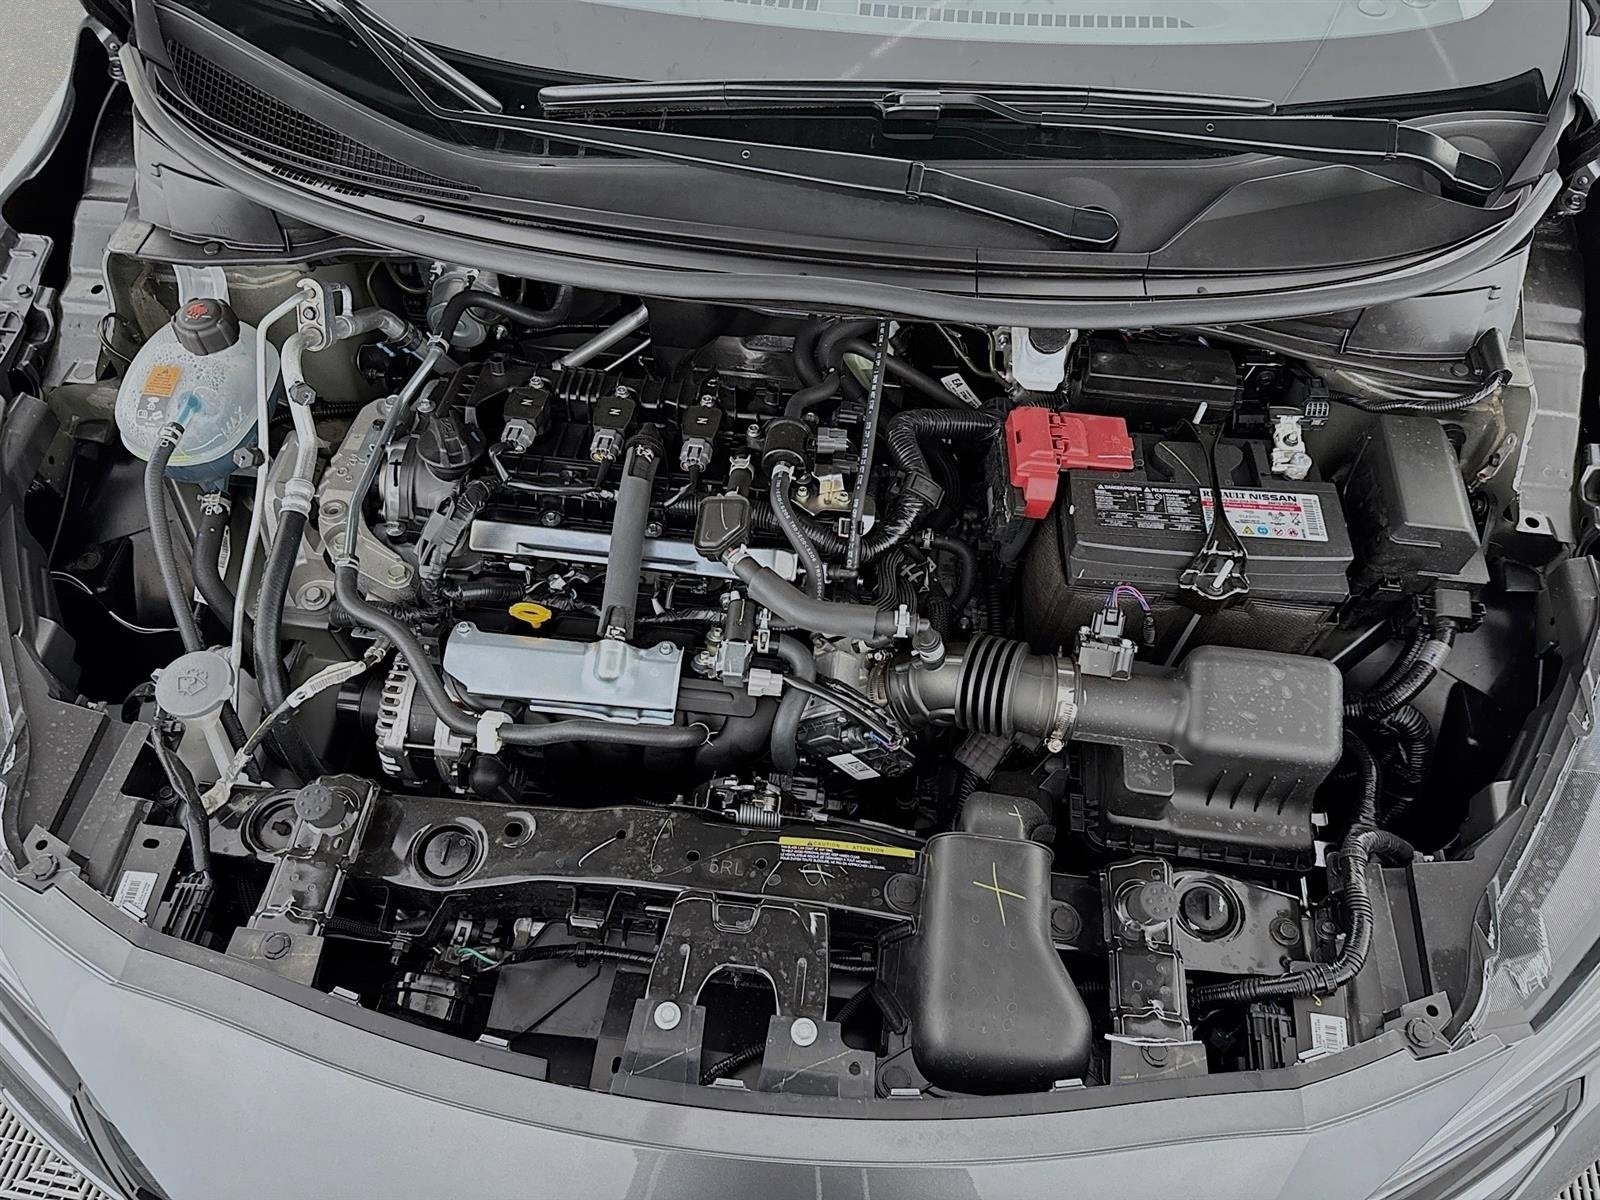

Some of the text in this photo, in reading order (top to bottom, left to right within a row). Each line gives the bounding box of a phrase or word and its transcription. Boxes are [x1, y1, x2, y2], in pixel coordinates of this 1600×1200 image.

[1202, 490, 1246, 500] RAULT
[1249, 493, 1297, 502] NISSAN
[814, 841, 840, 849] CAUTION
[853, 845, 884, 853] ATTENTION
